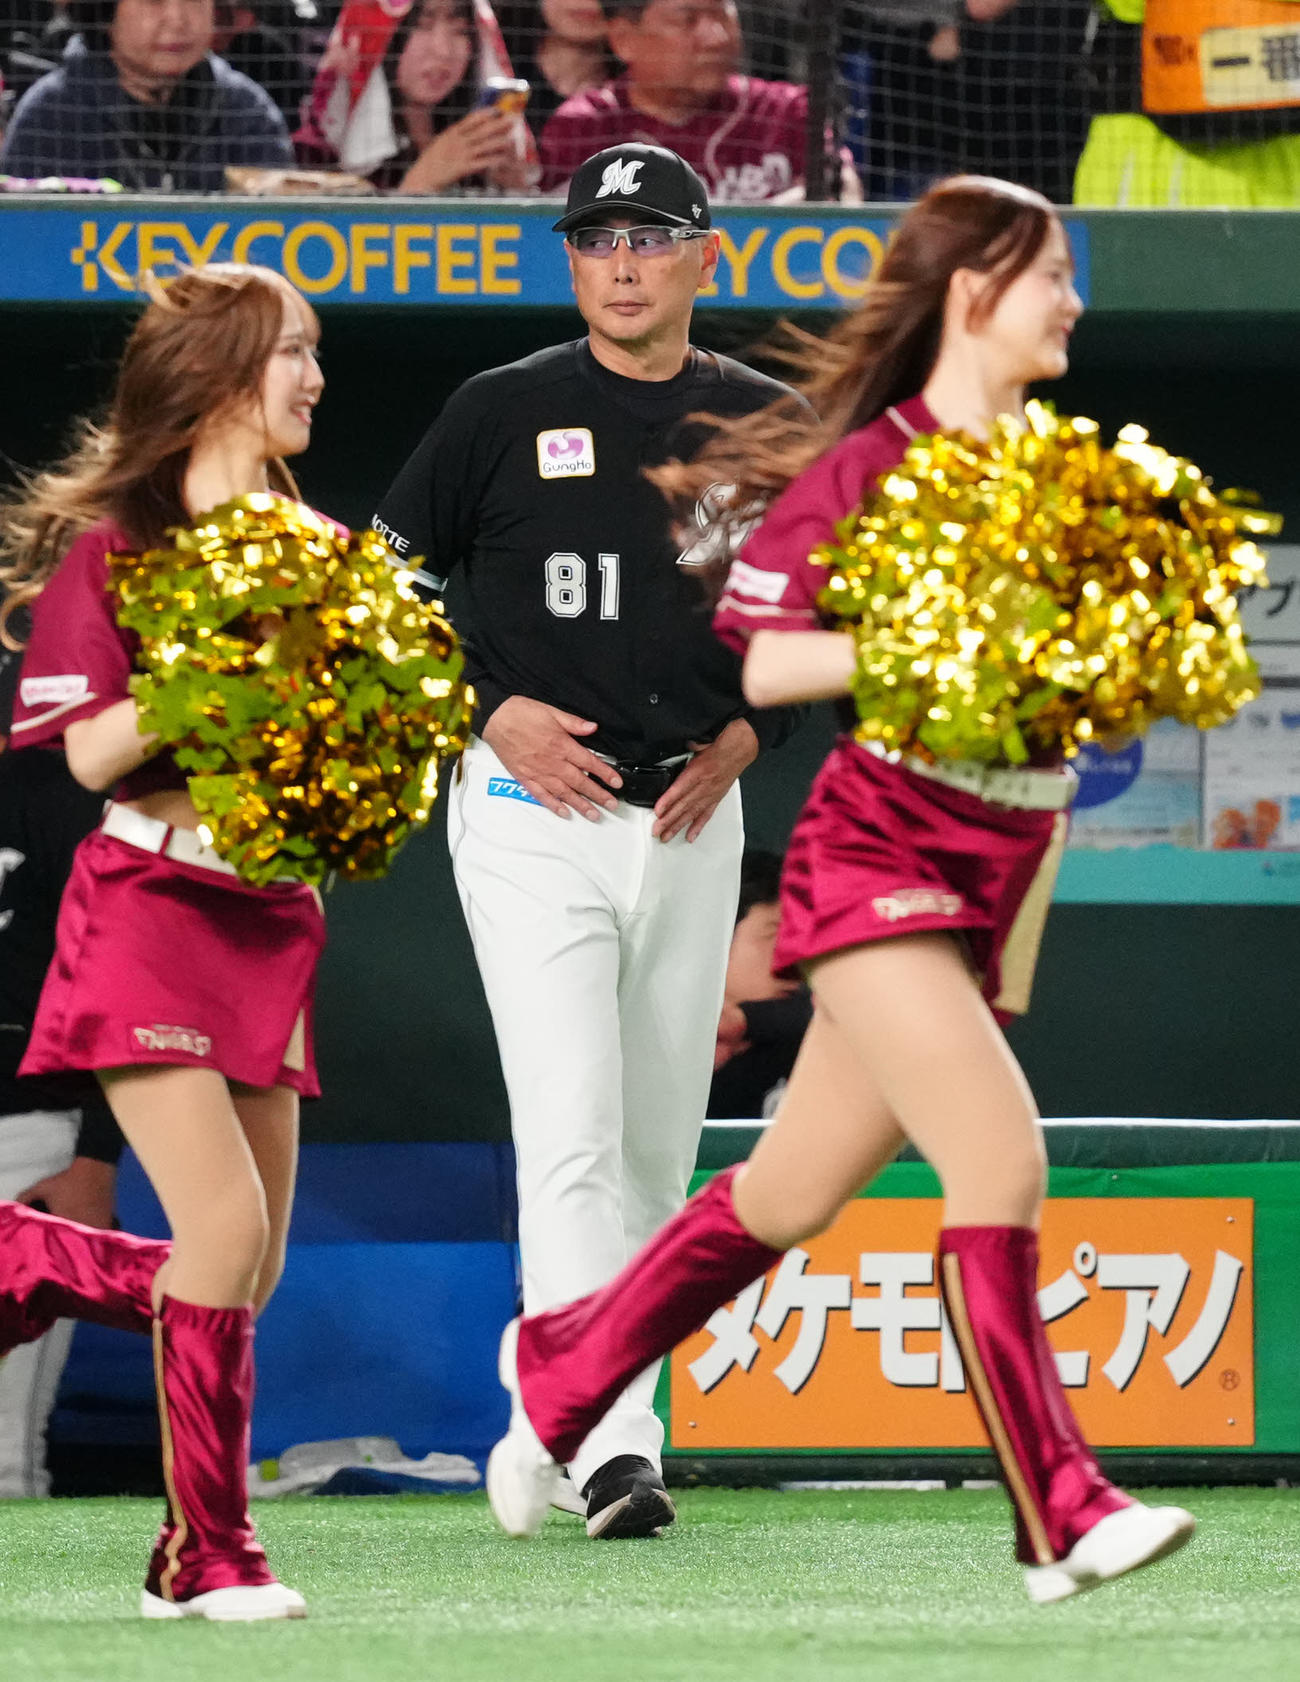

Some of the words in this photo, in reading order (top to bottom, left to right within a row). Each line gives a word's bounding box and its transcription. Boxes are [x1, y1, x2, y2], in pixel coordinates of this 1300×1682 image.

[543, 459, 592, 473] GungHo
[545, 552, 620, 620] 81
[687, 1240, 1244, 1396] タケモピアノ
